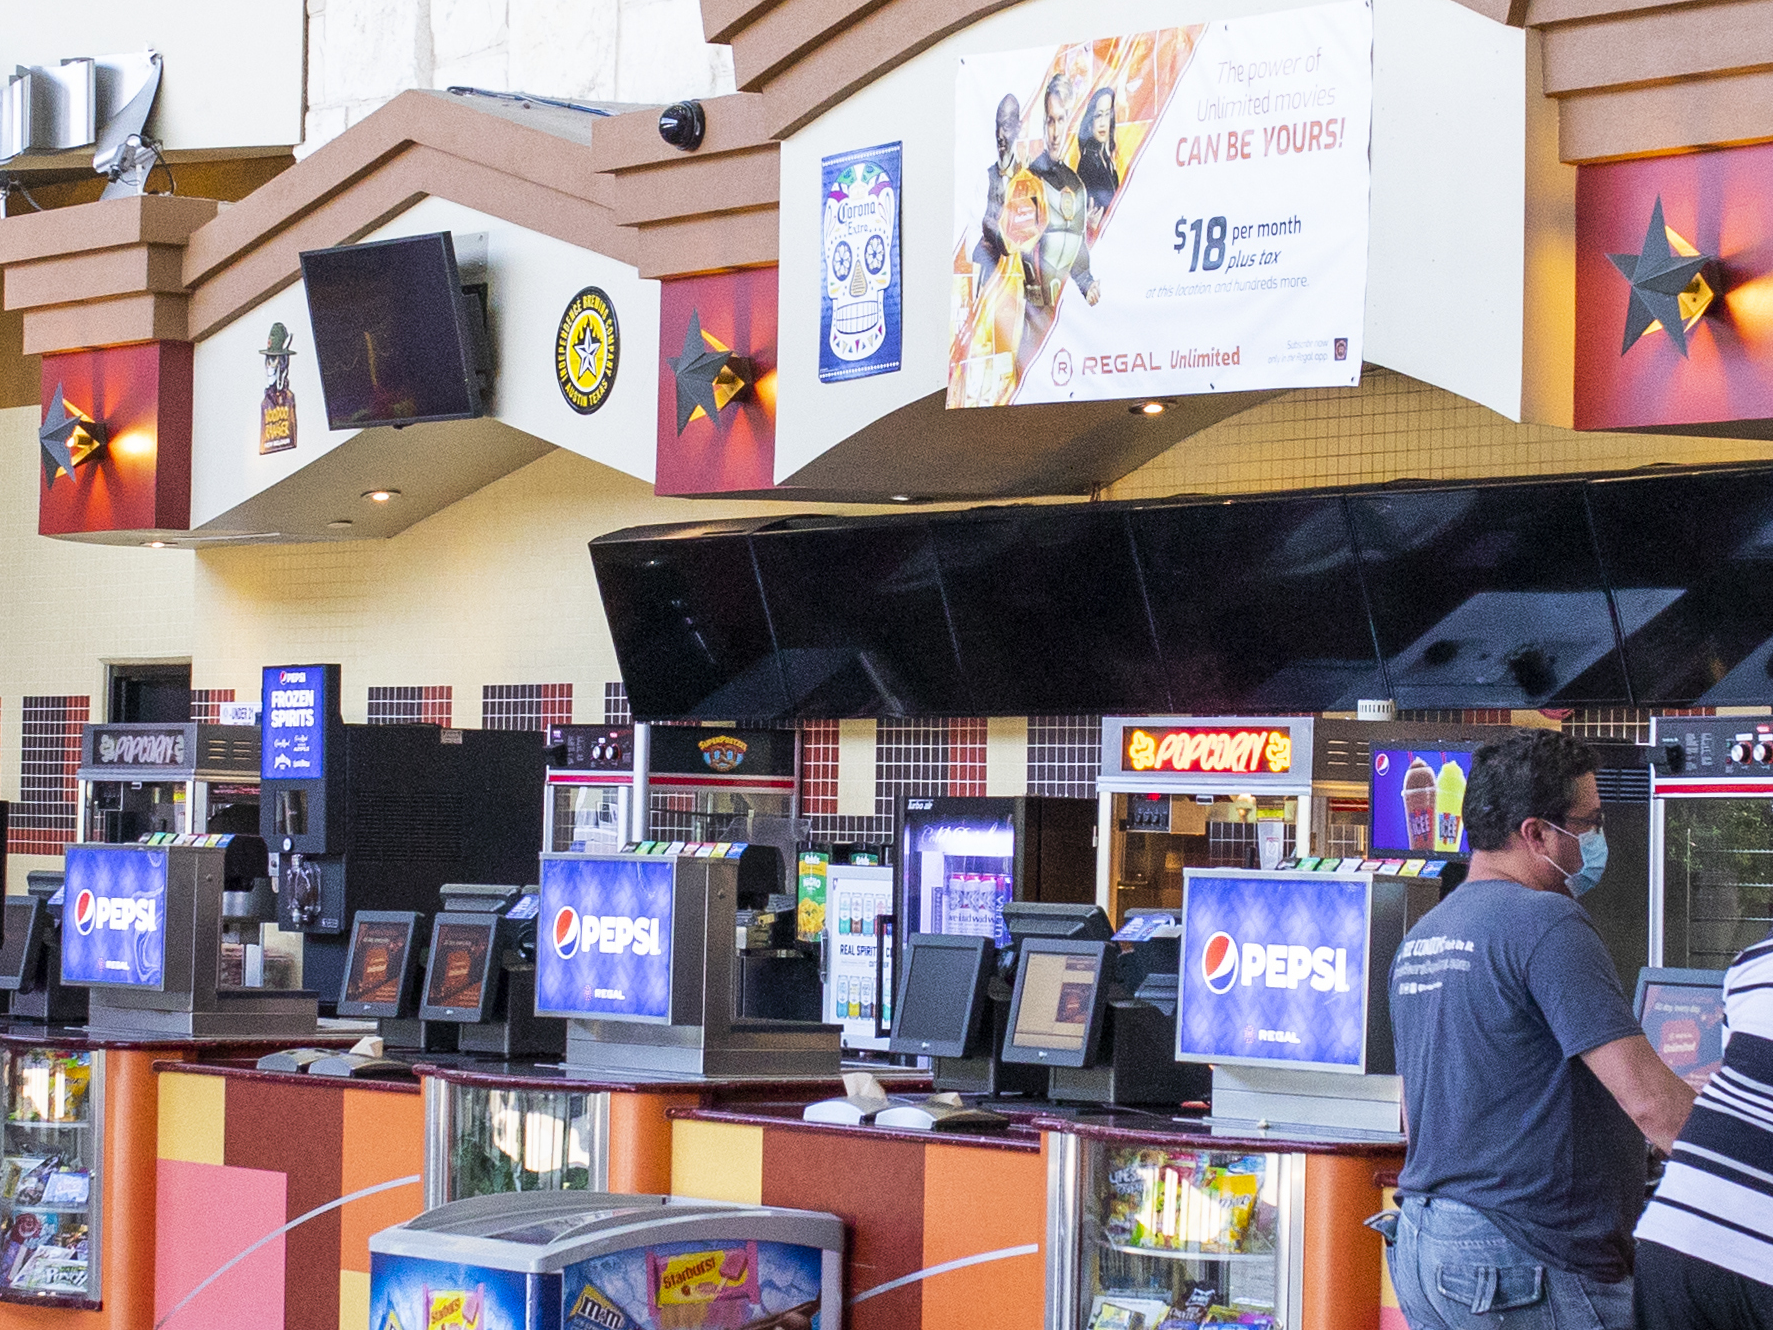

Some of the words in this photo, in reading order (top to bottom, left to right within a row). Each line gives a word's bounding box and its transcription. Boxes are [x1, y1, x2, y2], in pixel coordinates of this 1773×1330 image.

[1218, 60, 1244, 84] The
[1248, 57, 1301, 87] power
[1306, 47, 1322, 72] of
[1197, 90, 1270, 122] Unlimited
[1275, 85, 1335, 112] movies
[1176, 133, 1221, 167] CAN
[1226, 130, 1254, 161] BE
[1263, 117, 1345, 157] YOURS!
[838, 201, 876, 225] Corona
[847, 222, 869, 236] Extra
[1174, 215, 1227, 273] $18
[1232, 224, 1254, 245] per
[1257, 215, 1302, 238] month
[1224, 250, 1257, 274] plus
[1259, 250, 1282, 266] tax
[1145, 287, 1157, 299] at
[1158, 285, 1176, 297] this
[1214, 281, 1231, 293] and
[1233, 276, 1278, 292] hundreds
[558, 300, 582, 382] INDEPENDENCE
[605, 319, 615, 377] COMPANY
[1082, 352, 1162, 375] REGAL
[1170, 346, 1241, 369] Unlimited
[565, 382, 588, 407] AUSTIN
[589, 379, 607, 406] TEXAS
[287, 672, 306, 683] PEPSI
[271, 690, 314, 708] FROZEN
[271, 709, 314, 728] SPIRITS
[114, 735, 174, 763] POPCORN
[1154, 732, 1267, 771] POPCORN
[96, 897, 157, 931] PEPSI
[581, 915, 661, 956] PEPSI
[839, 945, 855, 957] REAL
[856, 946, 878, 957] SPIRIT
[1241, 943, 1349, 992] PEPSI
[594, 989, 625, 1000] REGAL
[1258, 1030, 1300, 1043] REGAL
